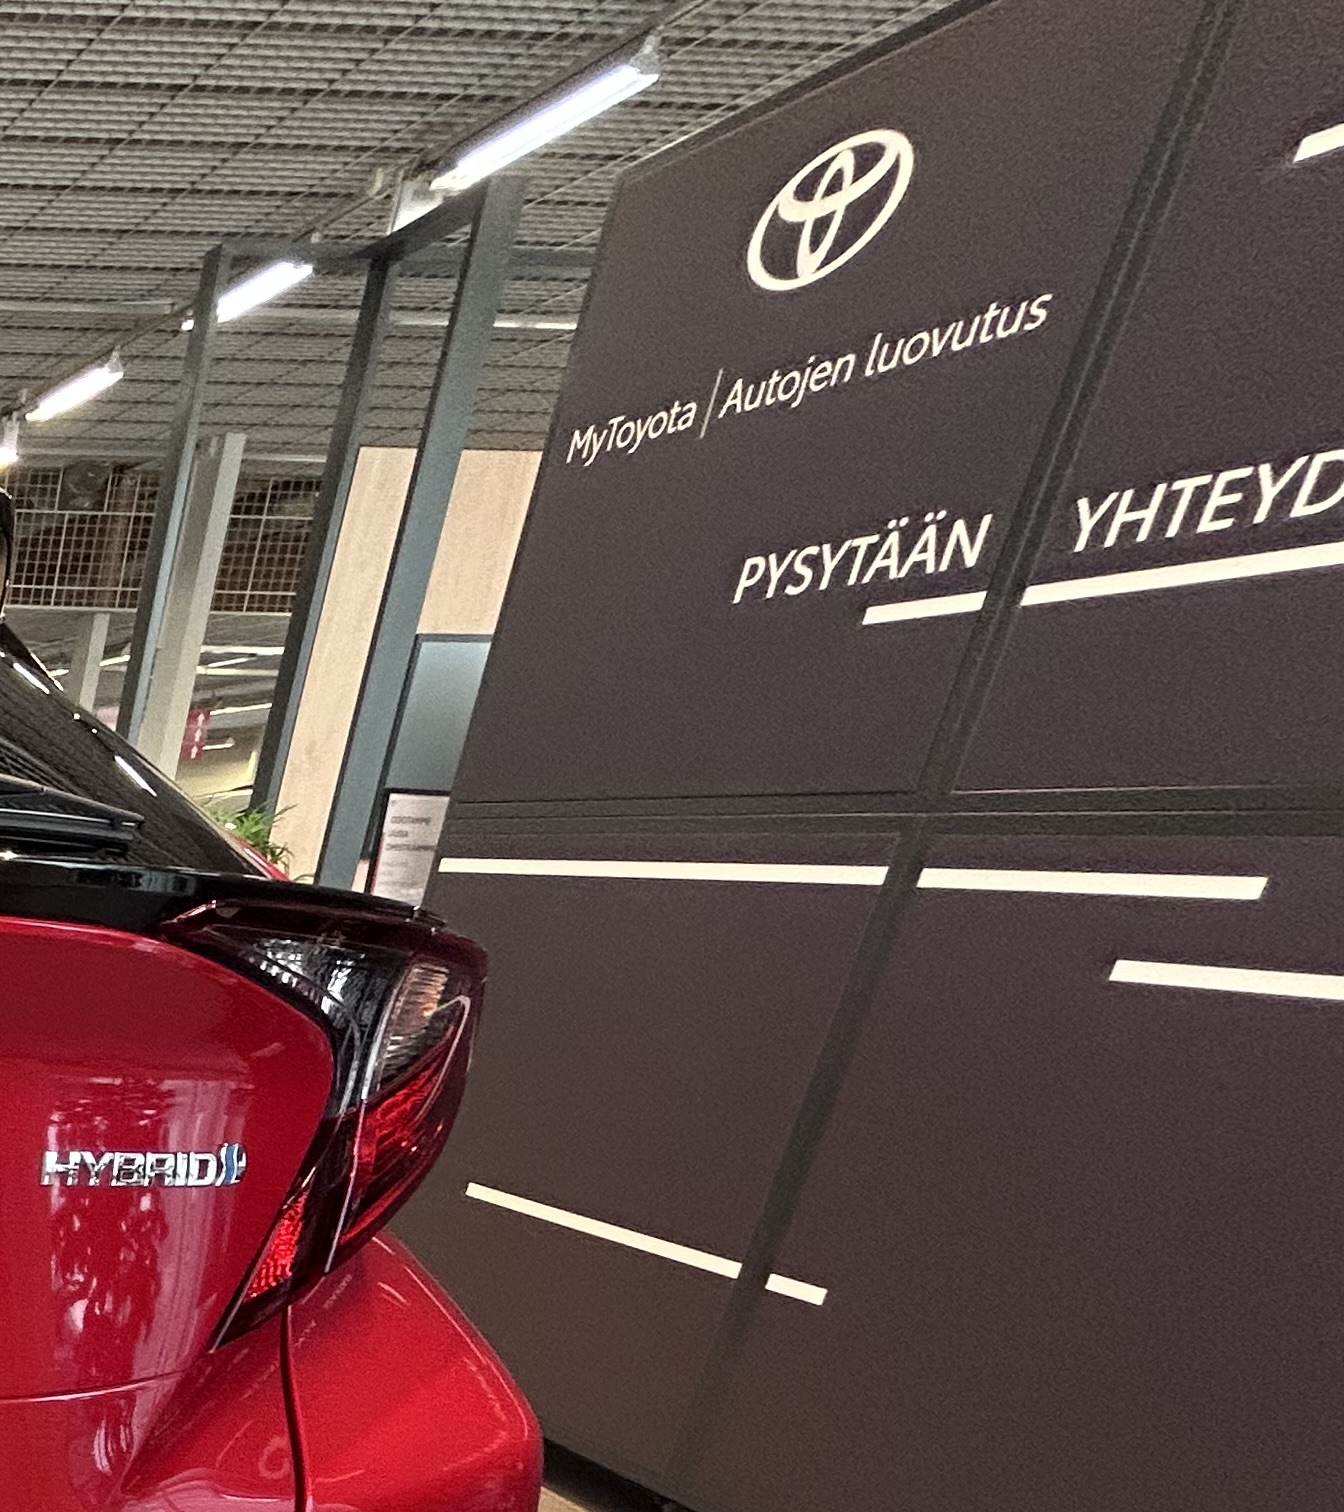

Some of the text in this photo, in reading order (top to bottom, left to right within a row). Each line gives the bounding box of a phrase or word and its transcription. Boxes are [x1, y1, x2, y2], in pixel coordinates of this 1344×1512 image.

[565, 293, 1053, 467] MyToyota Autojen luovutus
[732, 448, 1344, 604] PYSYTÄÄN YHTEYD
[41, 1150, 218, 1187] HYBRID
